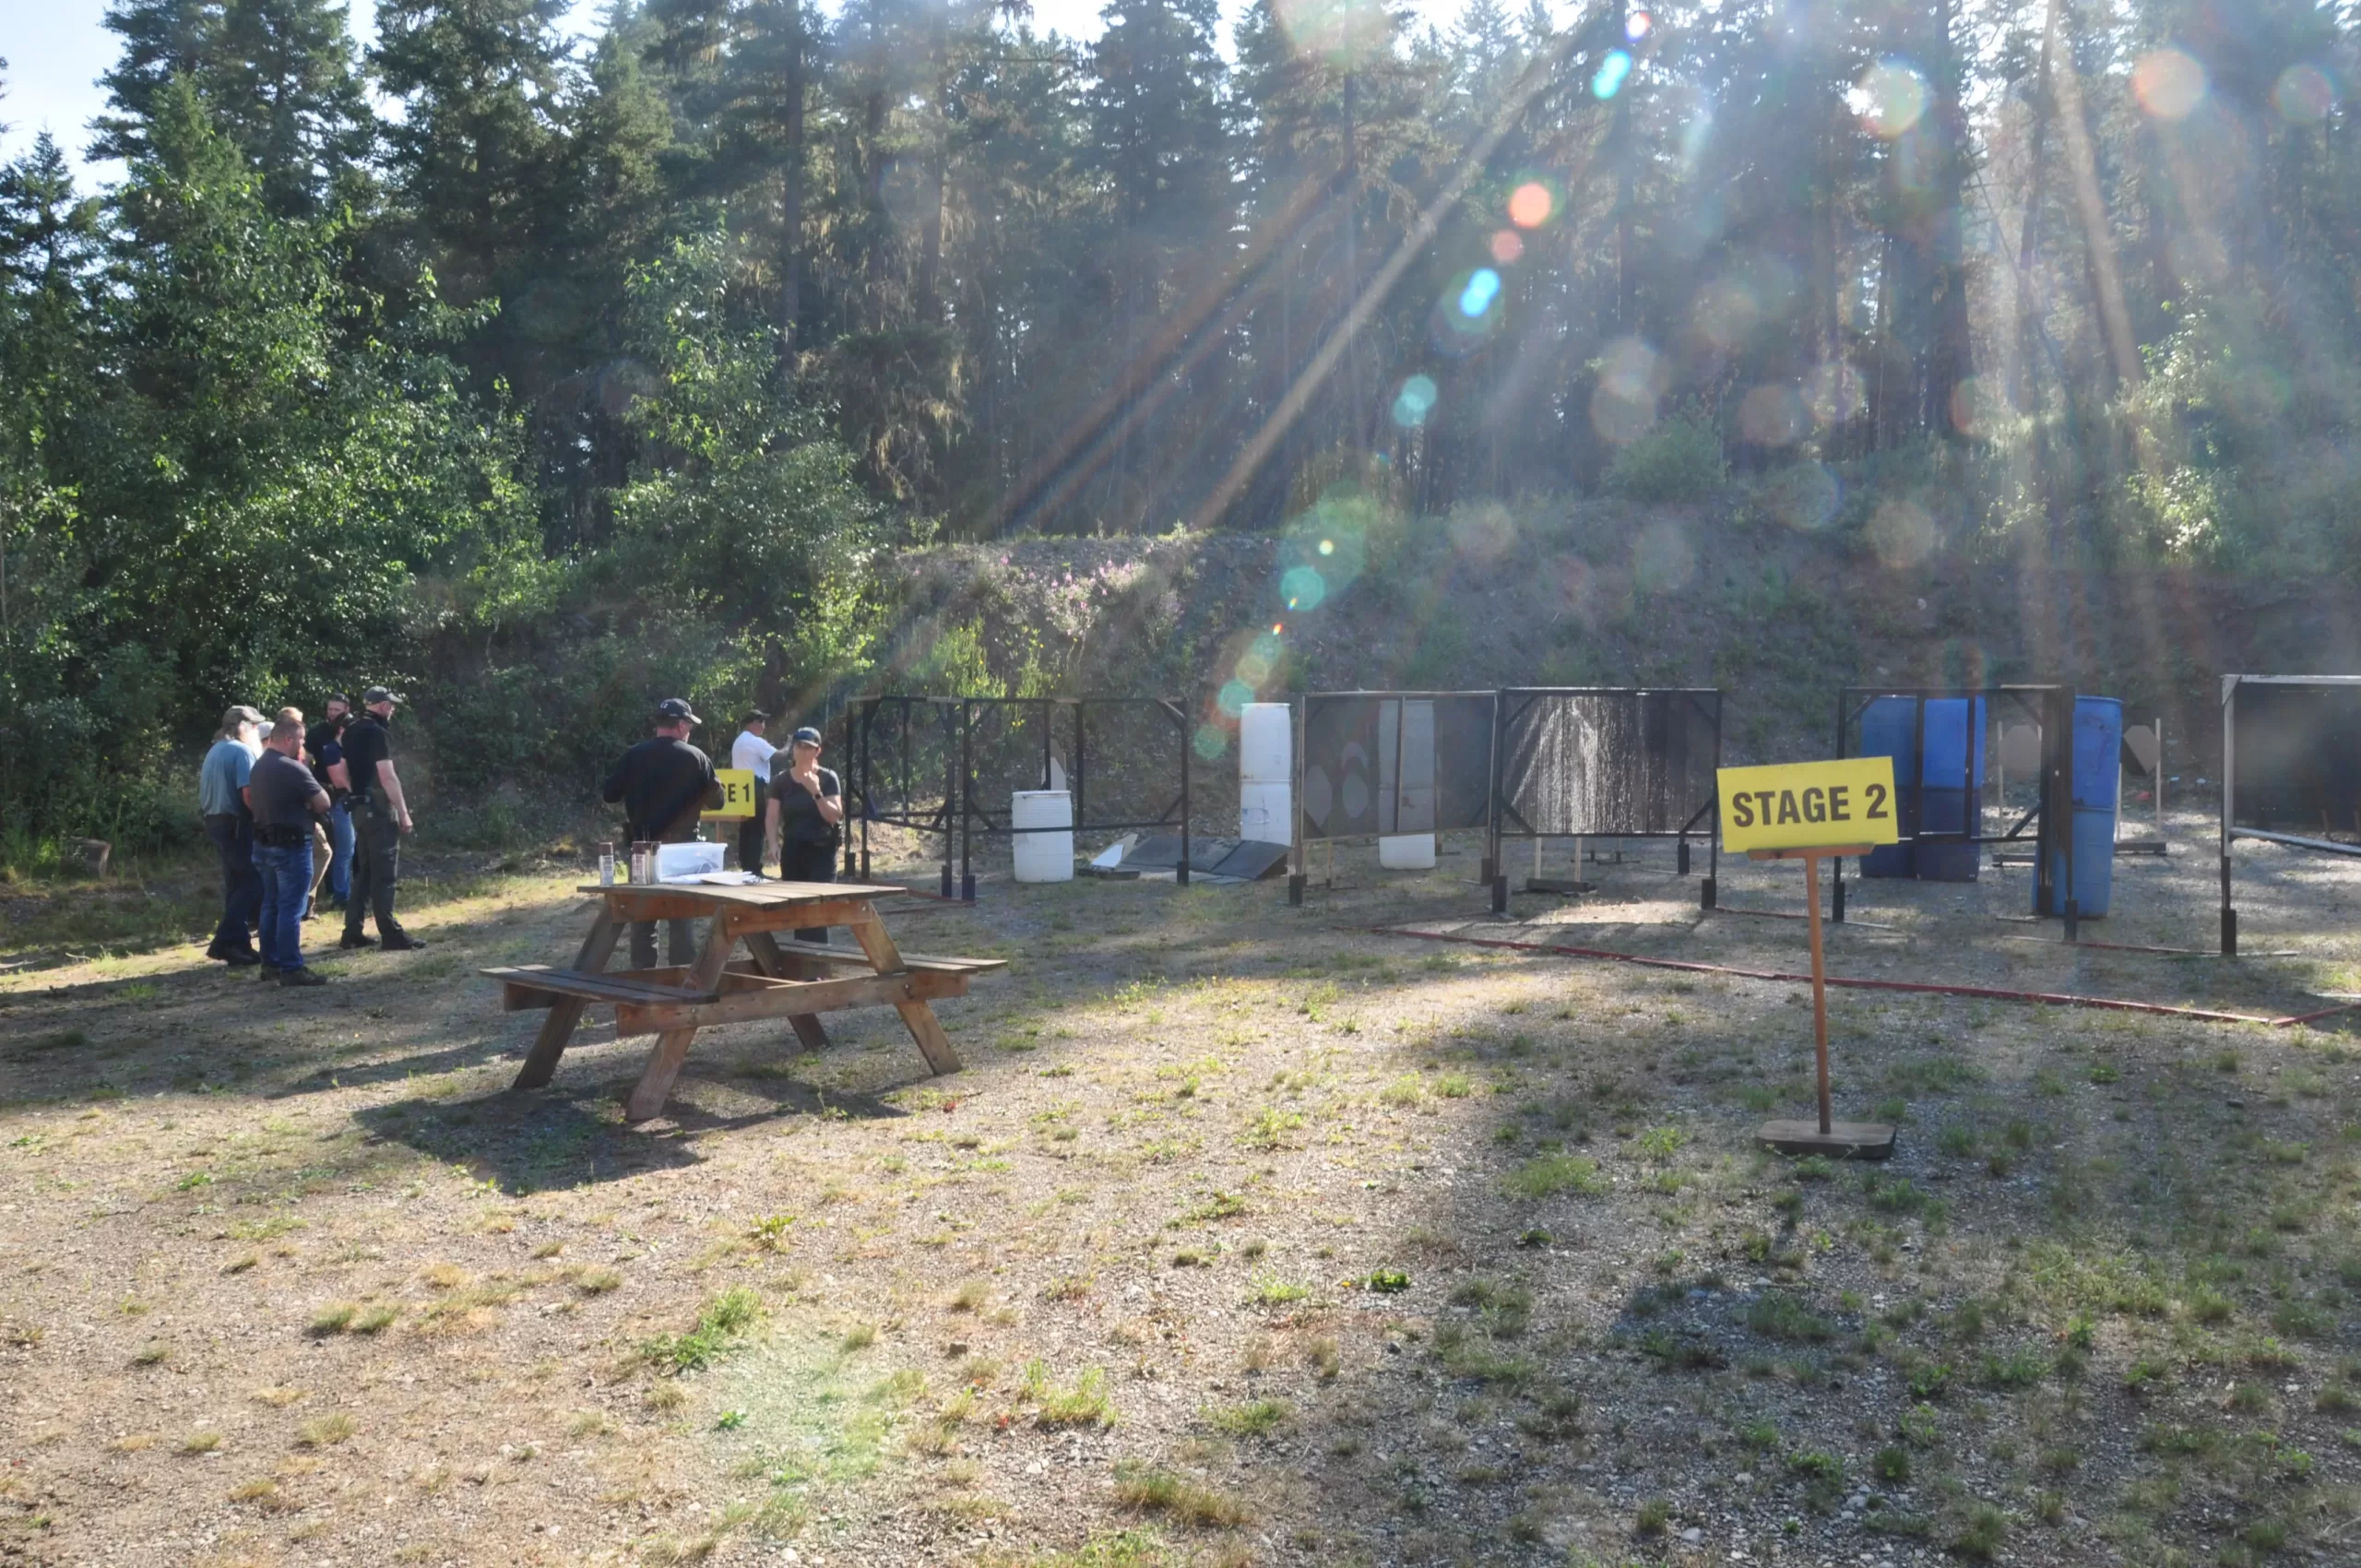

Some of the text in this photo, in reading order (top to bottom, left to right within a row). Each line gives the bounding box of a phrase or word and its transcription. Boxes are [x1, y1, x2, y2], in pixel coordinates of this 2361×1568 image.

[742, 783, 750, 802] 1
[1732, 784, 1888, 827] STAGE 2
